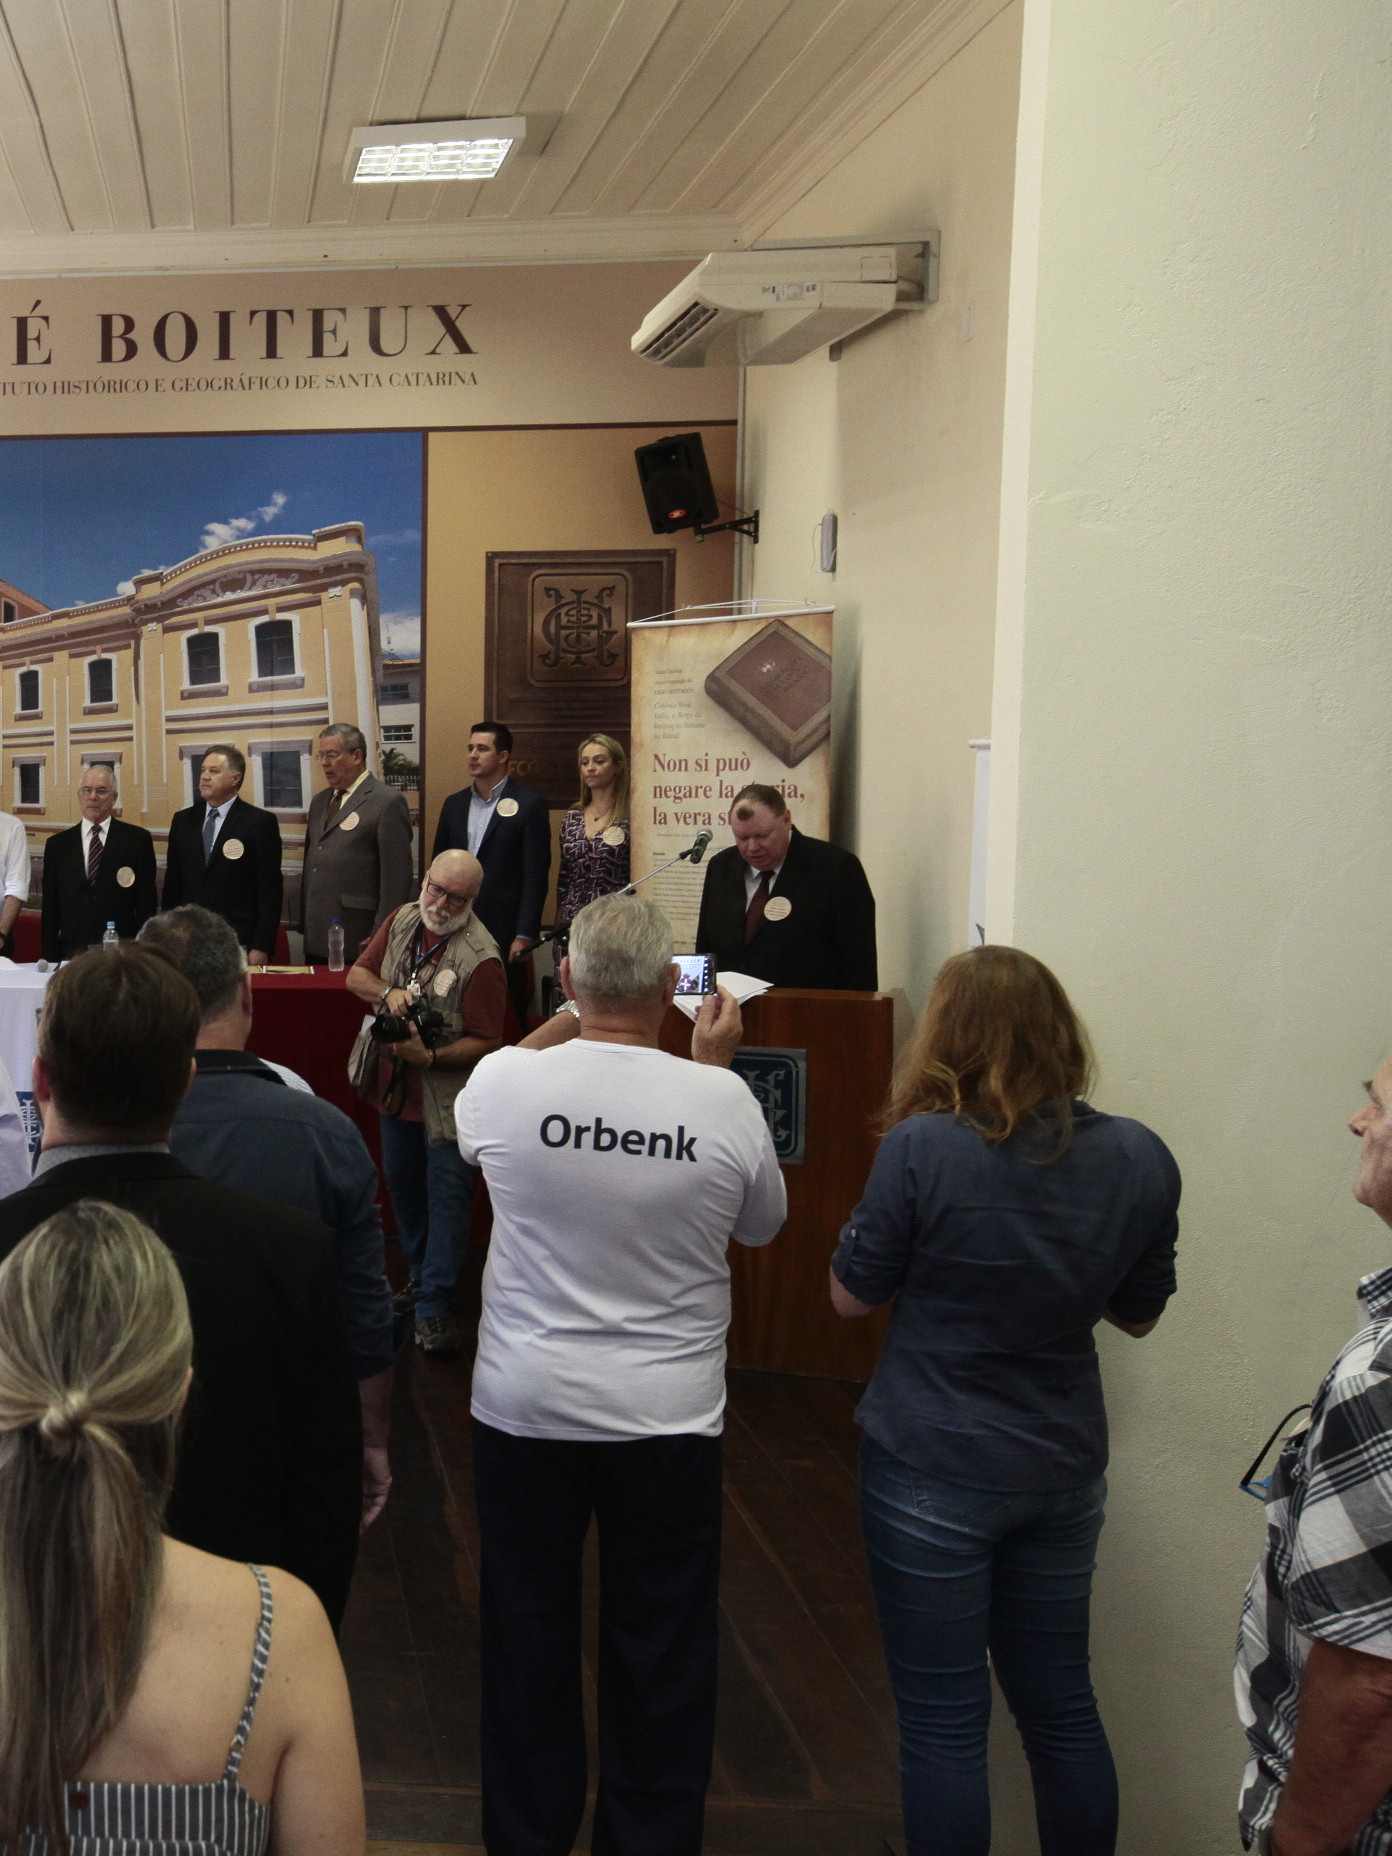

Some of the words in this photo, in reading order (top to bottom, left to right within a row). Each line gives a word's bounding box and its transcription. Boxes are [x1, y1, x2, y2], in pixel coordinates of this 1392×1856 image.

[95, 304, 479, 364] BOITEUX
[52, 376, 150, 396] HISTÓRICO
[154, 378, 166, 393] E
[171, 373, 290, 392] GEOGRÁFICO
[295, 375, 320, 390] DE
[325, 373, 384, 389] SANTA
[388, 371, 479, 387] CATARINA
[653, 753, 689, 773] Non
[694, 752, 709, 772] si
[715, 751, 751, 777] può
[653, 784, 713, 804] negare
[718, 779, 735, 799] la
[652, 806, 668, 826] la
[674, 811, 712, 826] vera
[539, 1113, 698, 1163] Orbenk
